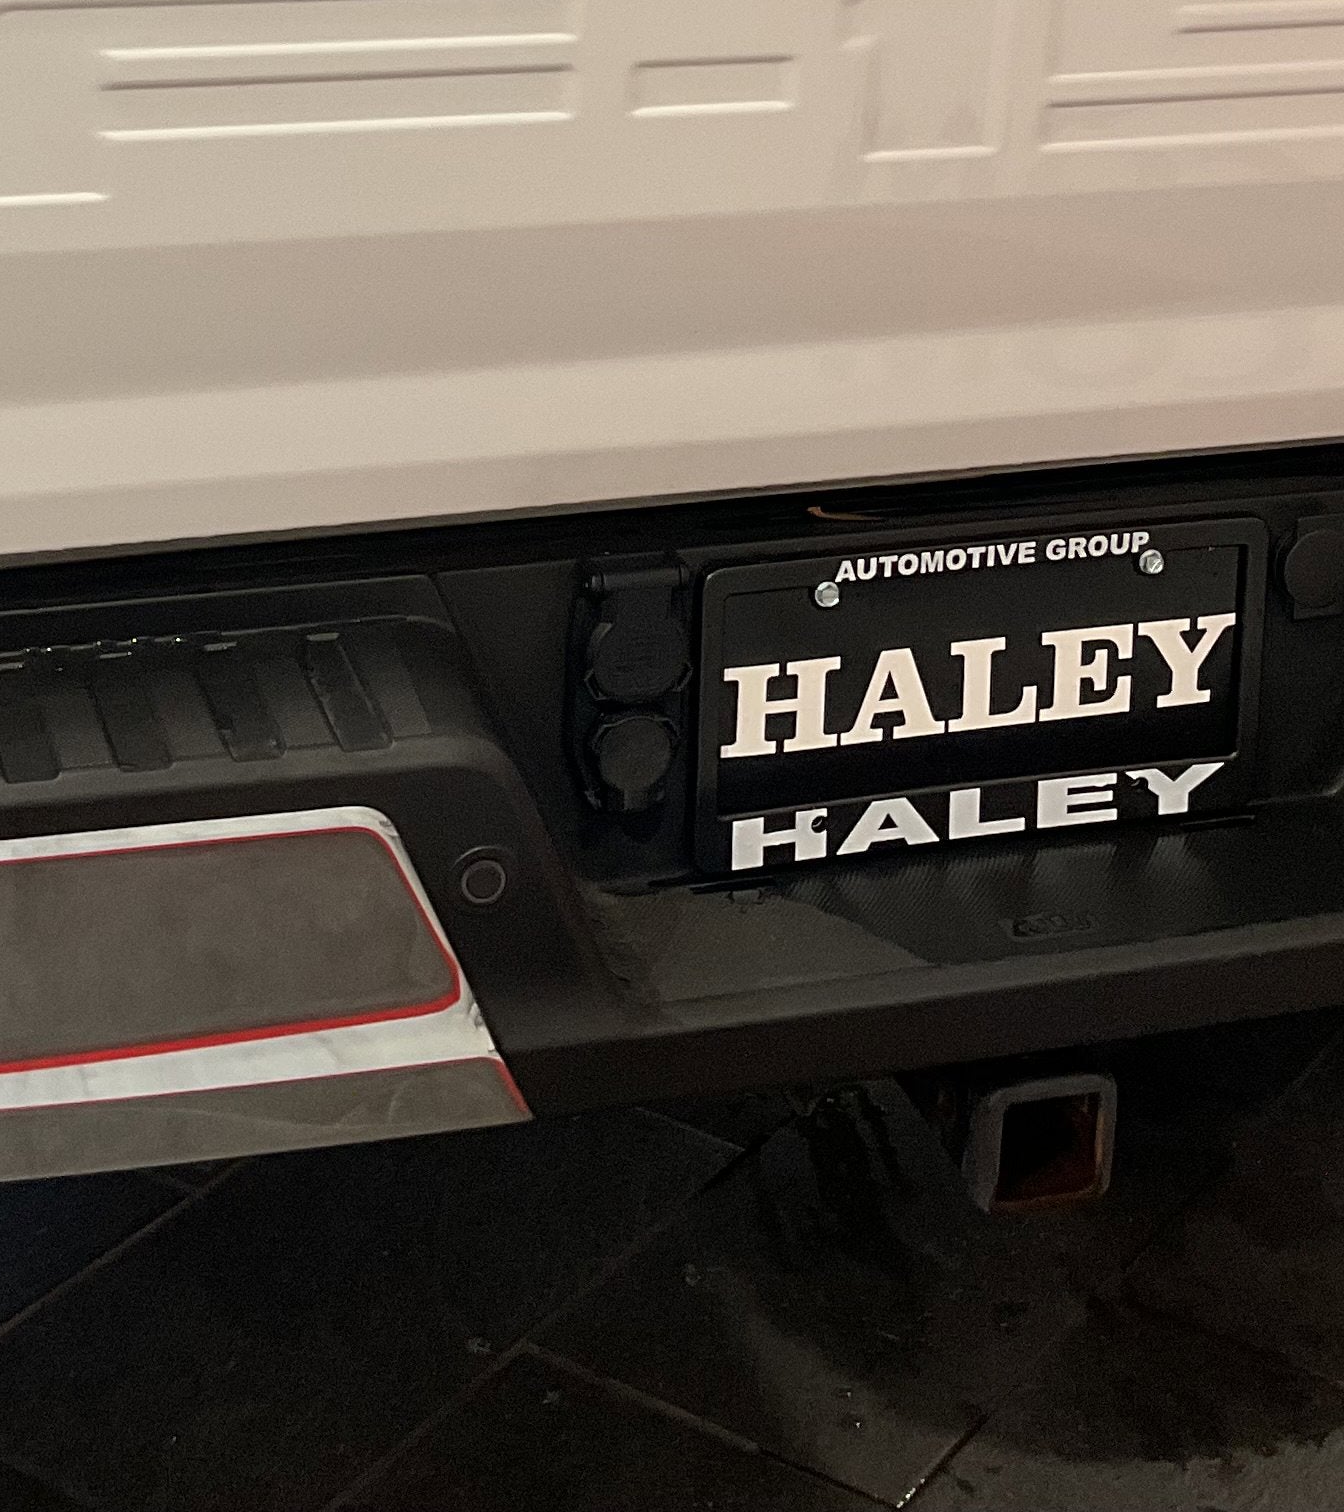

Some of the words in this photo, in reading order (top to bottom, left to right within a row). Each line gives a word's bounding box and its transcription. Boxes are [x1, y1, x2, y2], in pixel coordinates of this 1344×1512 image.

[835, 541, 1037, 583] AUTOMOTIVE
[1045, 531, 1150, 561] GROUP
[719, 612, 1237, 759] HALEY
[731, 761, 1225, 871] HALEY
